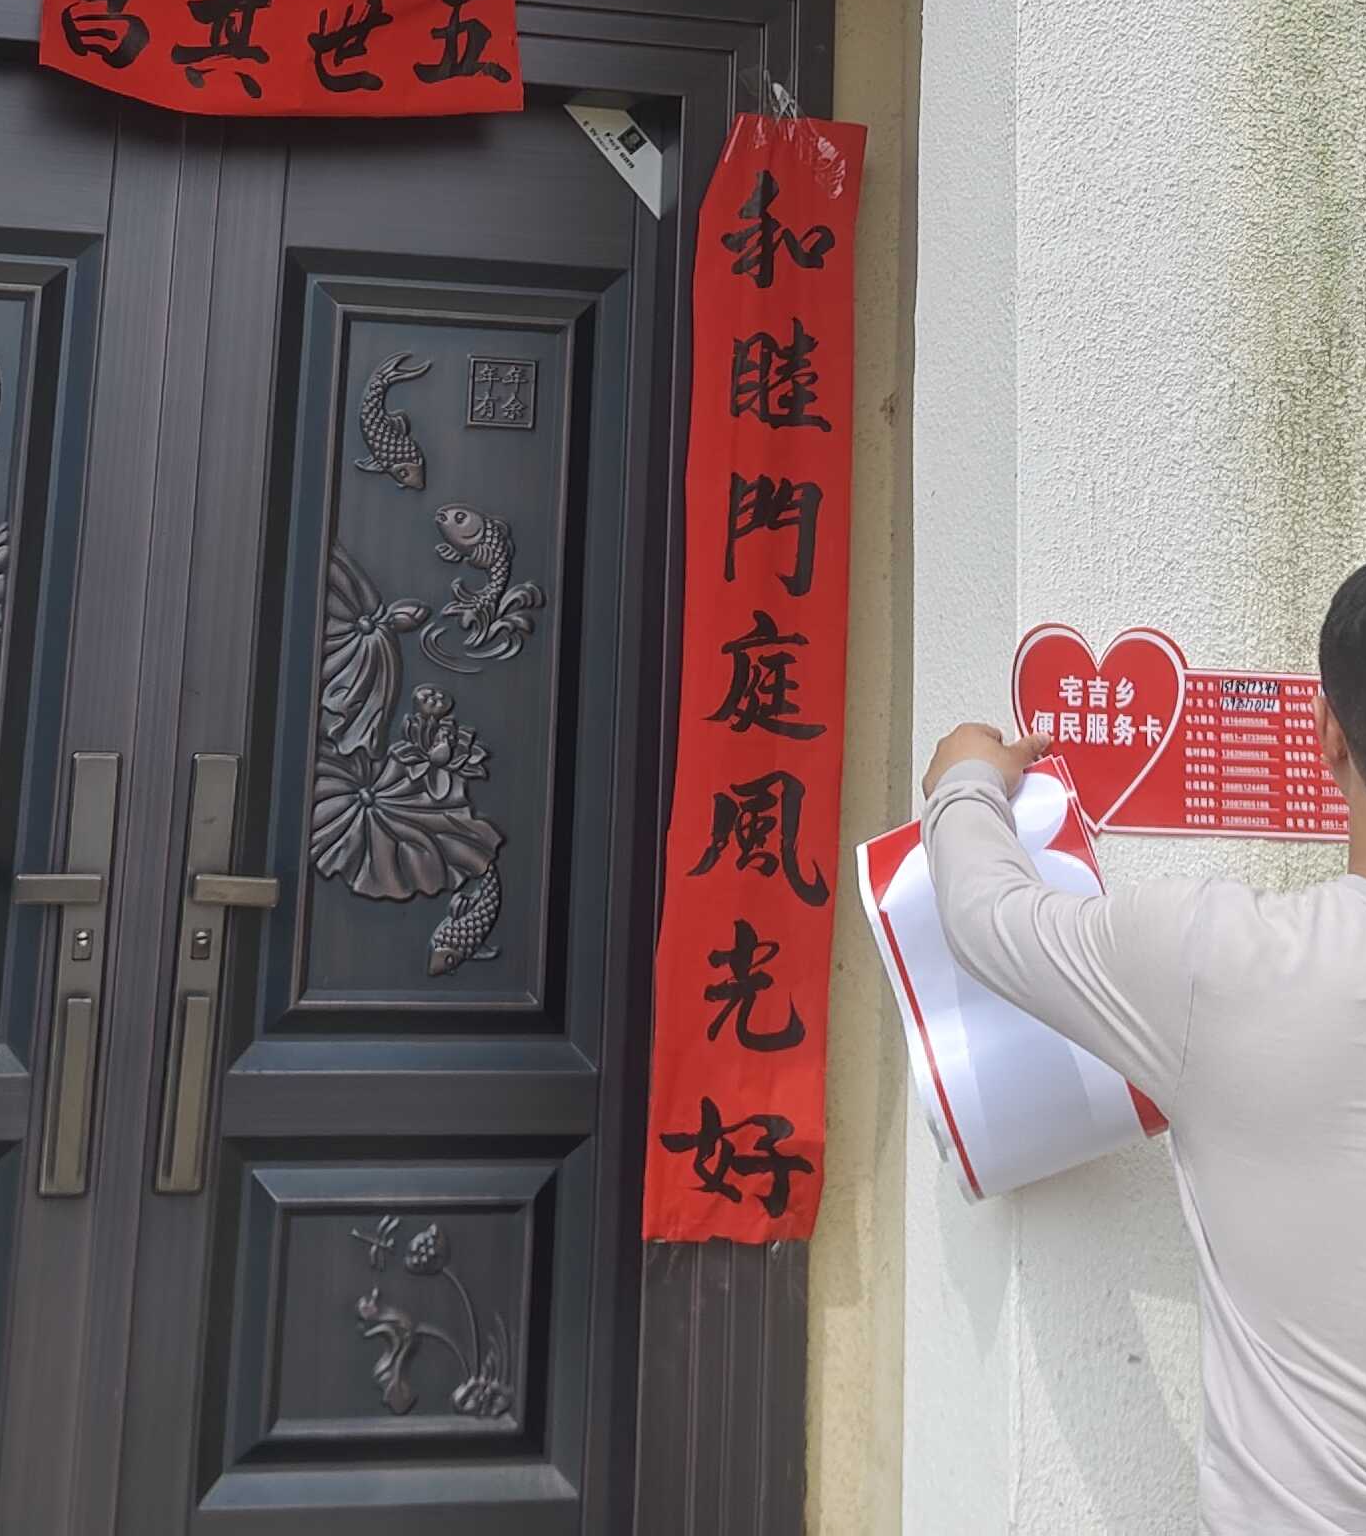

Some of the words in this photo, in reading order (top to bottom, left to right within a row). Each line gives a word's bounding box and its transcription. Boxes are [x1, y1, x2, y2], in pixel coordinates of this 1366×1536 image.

[660, 169, 836, 1218] 和睦門庭風光好
[1058, 675, 1135, 709] 宅吉乡
[1030, 711, 1164, 748] 便民服务卡
